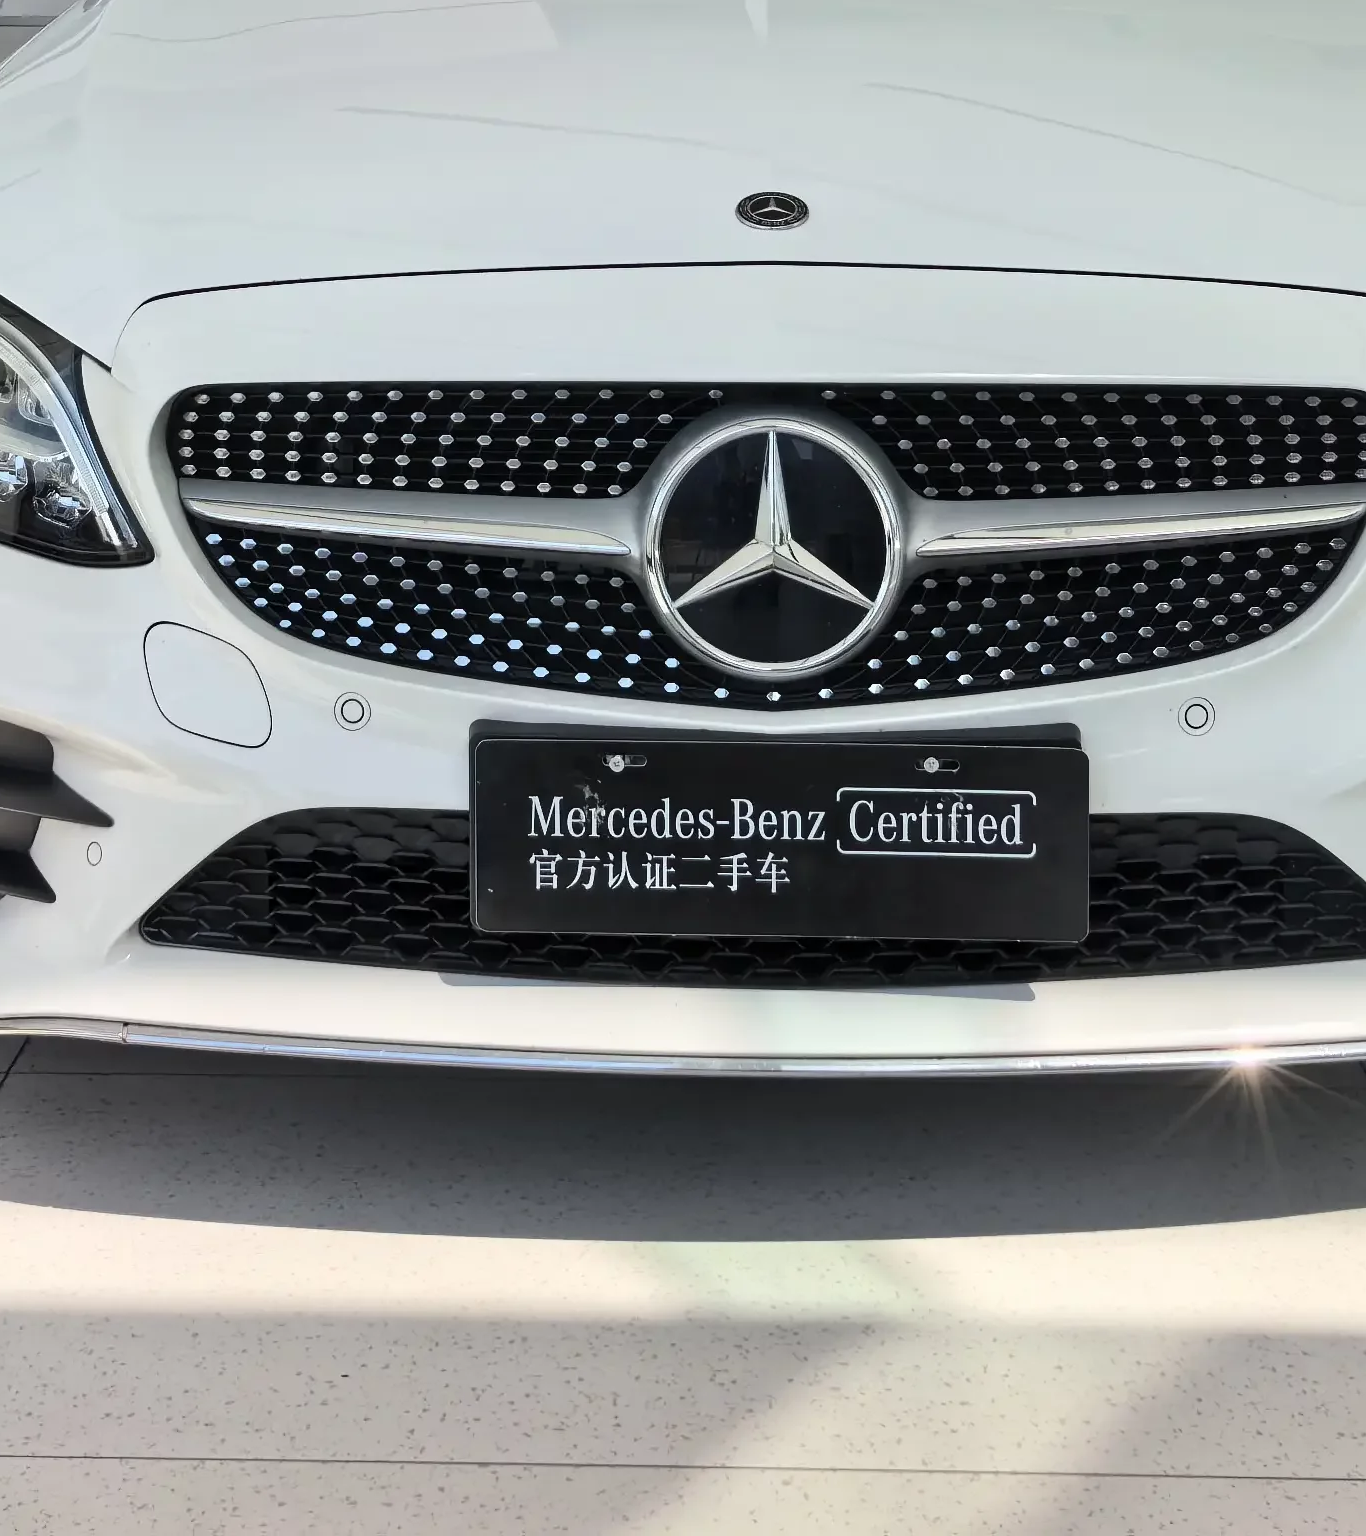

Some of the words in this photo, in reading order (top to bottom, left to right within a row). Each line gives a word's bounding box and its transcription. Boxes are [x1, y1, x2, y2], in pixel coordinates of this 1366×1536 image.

[528, 795, 826, 841] Mercedes-Benz
[849, 799, 1024, 845] Certified
[529, 849, 791, 894] 官方认证二手车
